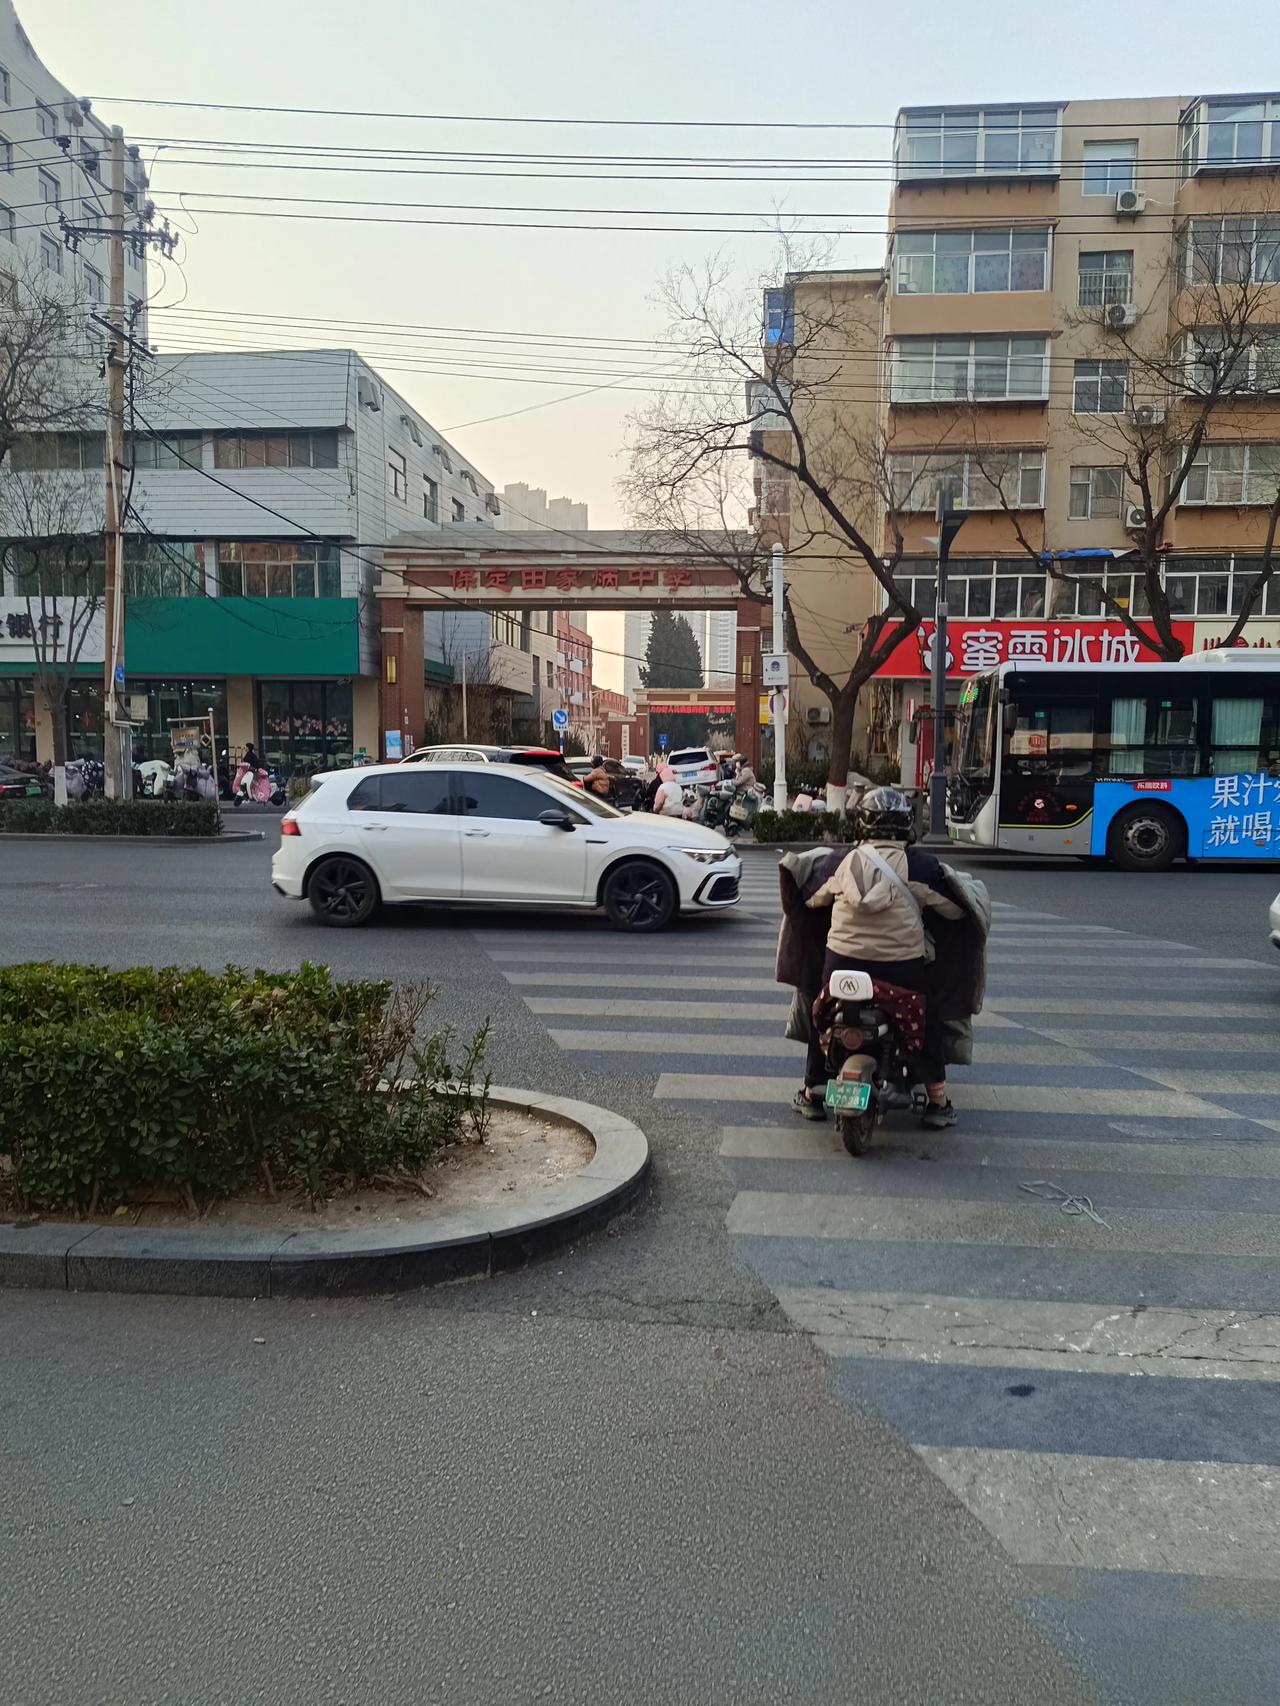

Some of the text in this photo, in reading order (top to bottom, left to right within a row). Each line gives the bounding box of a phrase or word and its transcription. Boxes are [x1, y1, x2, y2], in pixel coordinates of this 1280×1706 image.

[0, 612, 64, 639] 银行
[960, 629, 1140, 671] 蜜雪冰城
[1208, 811, 1280, 847] 就喝
